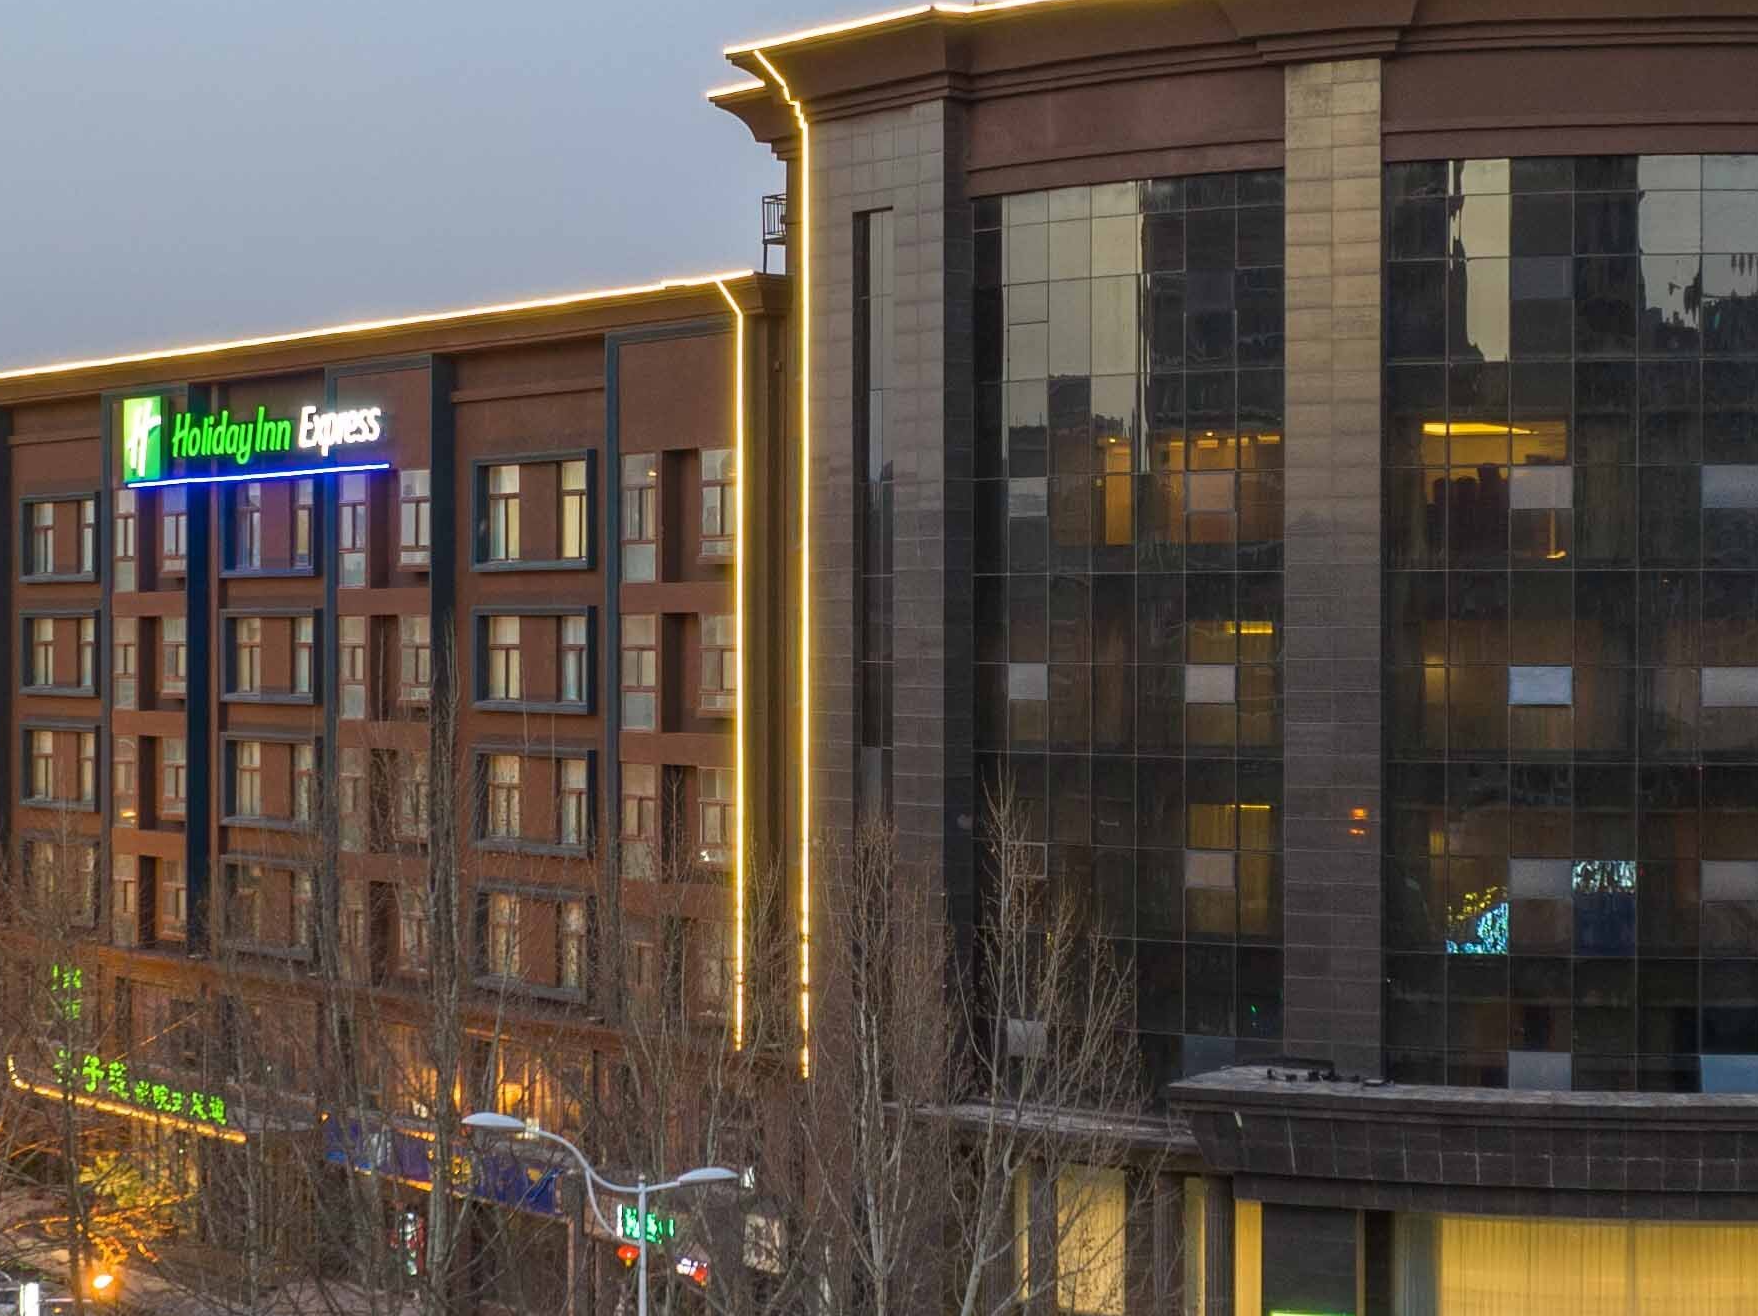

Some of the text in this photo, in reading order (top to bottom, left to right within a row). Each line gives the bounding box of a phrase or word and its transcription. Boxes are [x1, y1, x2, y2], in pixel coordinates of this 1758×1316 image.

[172, 406, 381, 465] Holiday Inn Express
